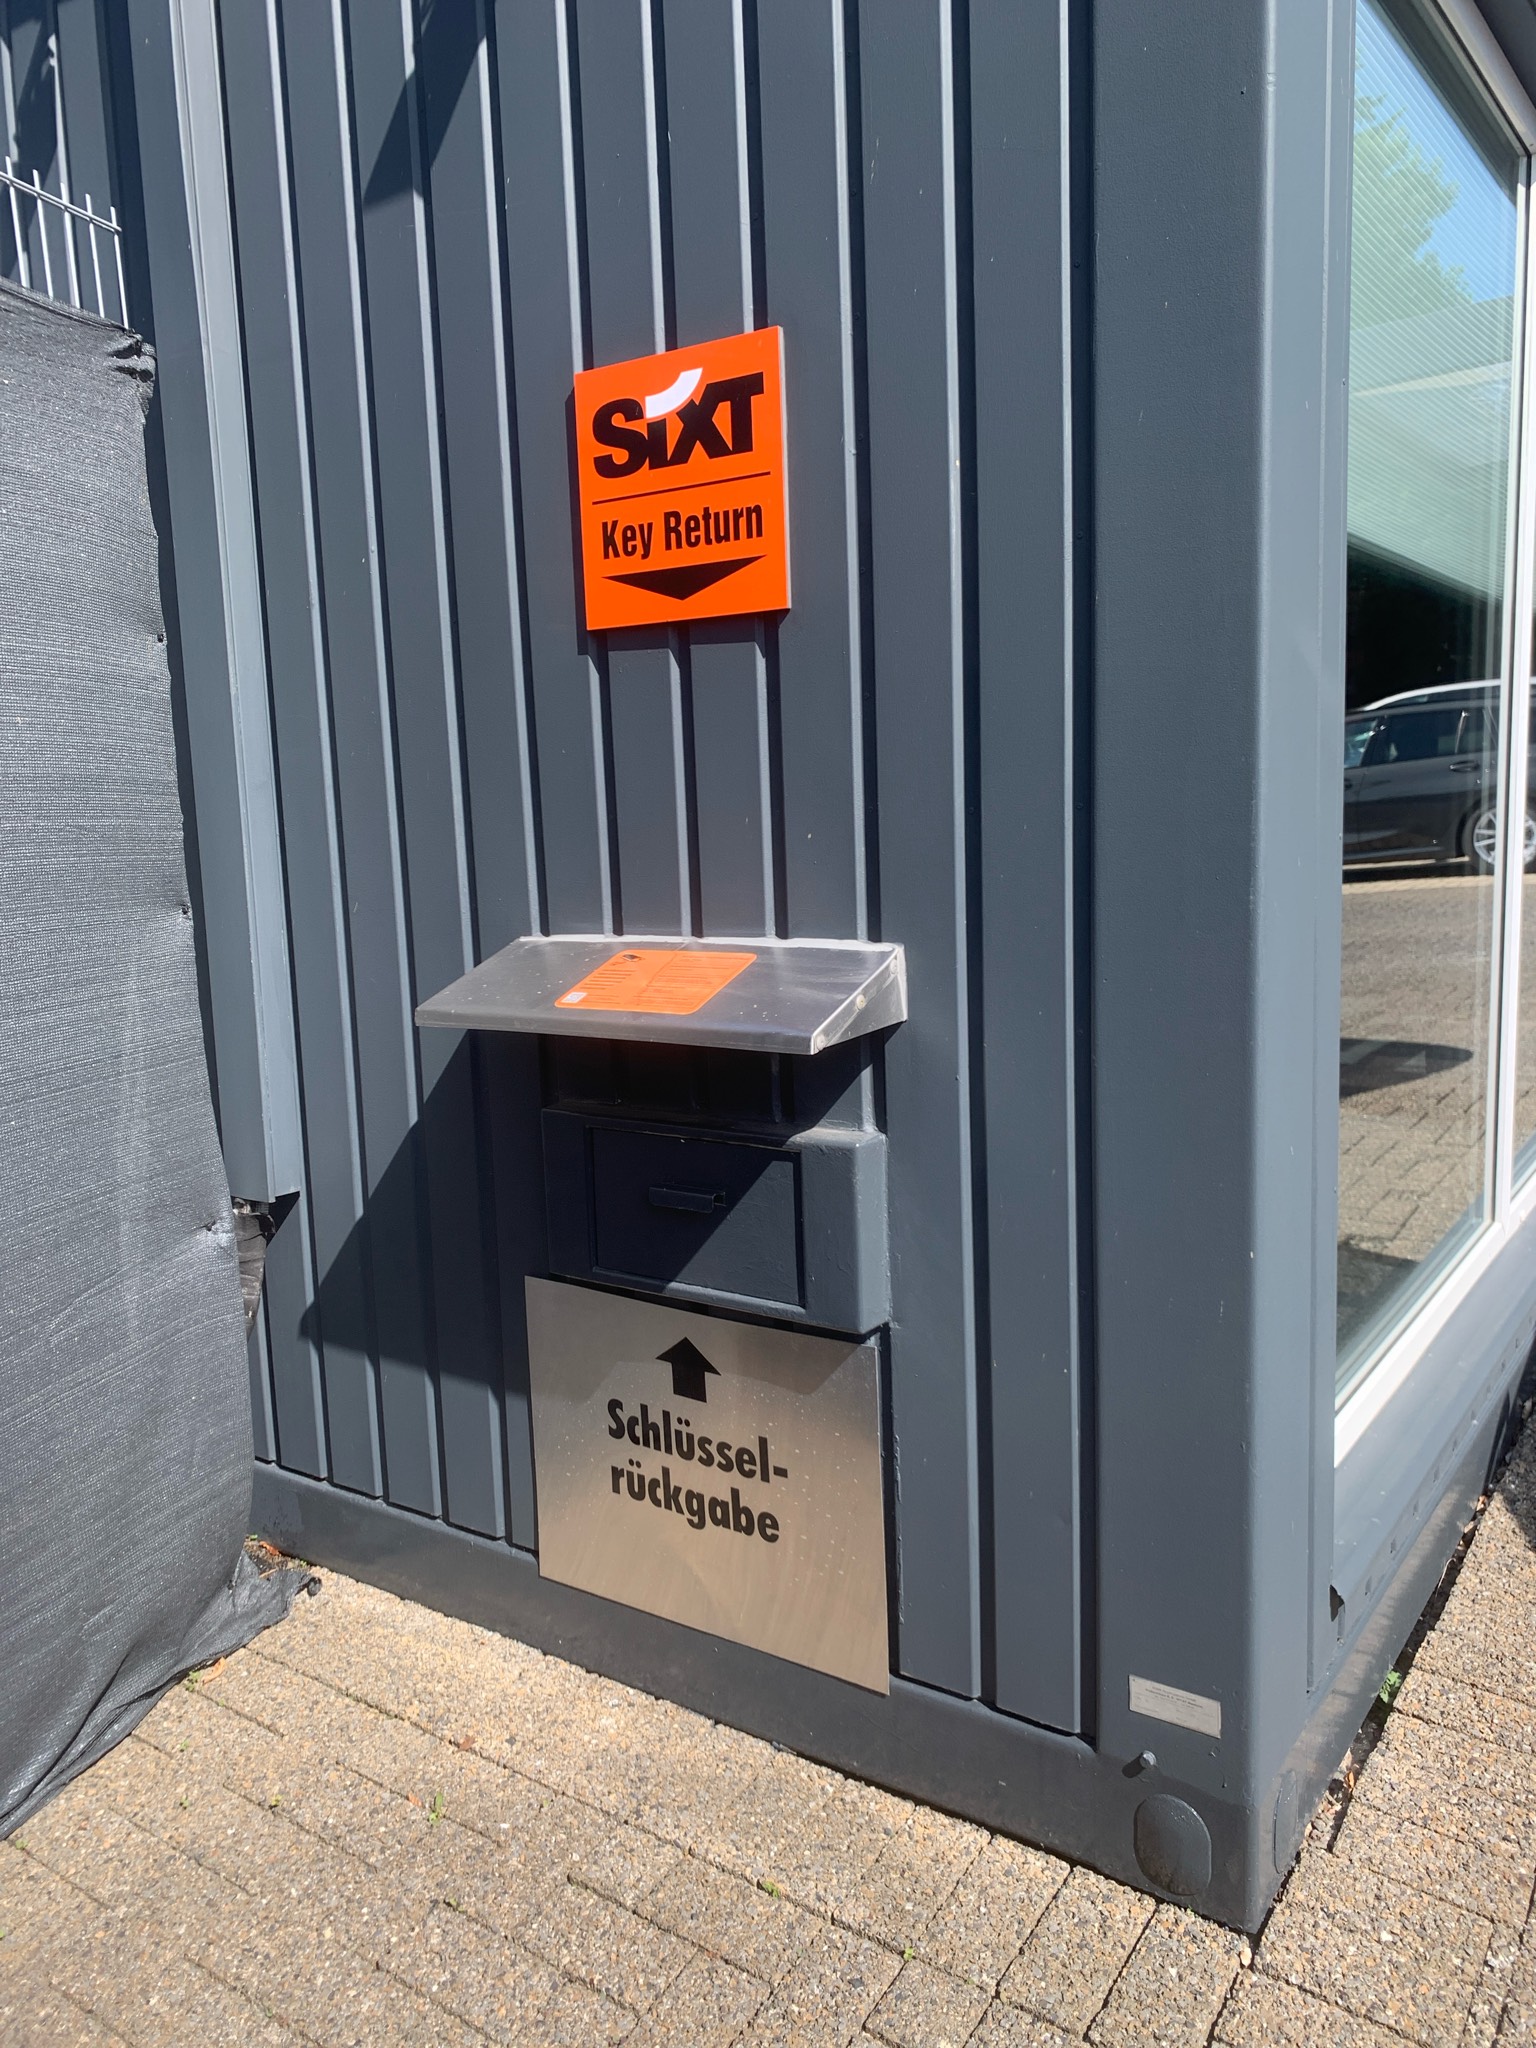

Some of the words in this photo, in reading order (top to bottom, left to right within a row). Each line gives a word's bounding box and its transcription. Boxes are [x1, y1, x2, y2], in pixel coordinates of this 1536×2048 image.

[602, 518, 654, 561] Key
[664, 503, 763, 550] Return
[607, 1399, 788, 1483] Schlüssel-
[610, 1458, 780, 1543] rückgabe
